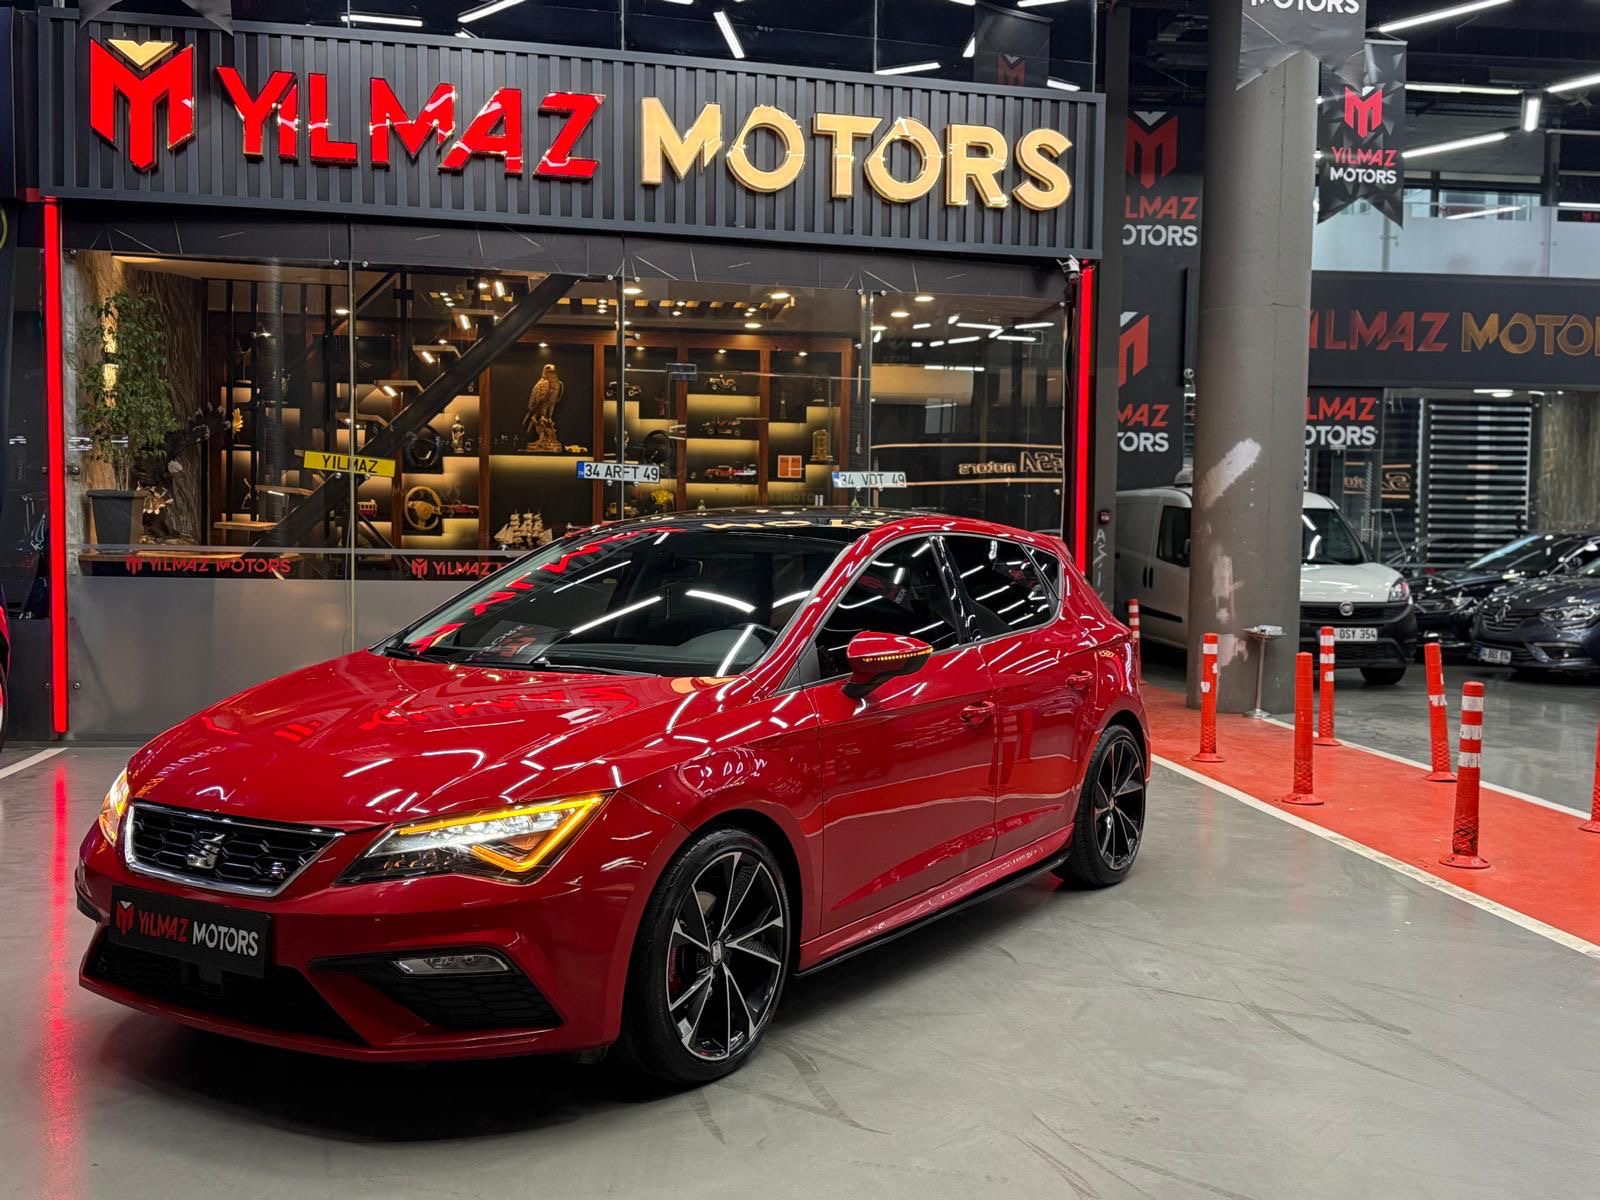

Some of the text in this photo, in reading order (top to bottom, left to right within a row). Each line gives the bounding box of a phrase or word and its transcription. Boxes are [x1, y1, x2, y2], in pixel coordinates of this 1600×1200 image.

[215, 65, 1074, 211] YILMAZ MOTORS
[1331, 146, 1397, 167] YILMAZ
[1329, 166, 1397, 184] MOTORS
[1461, 311, 1600, 357] MOTO
[585, 463, 600, 478] 34
[643, 467, 659, 481] 49
[150, 558, 292, 574] YILMAZ MOTORS
[432, 561, 492, 577] YILMAZ
[138, 909, 260, 957] YILMAZ MOTORS
